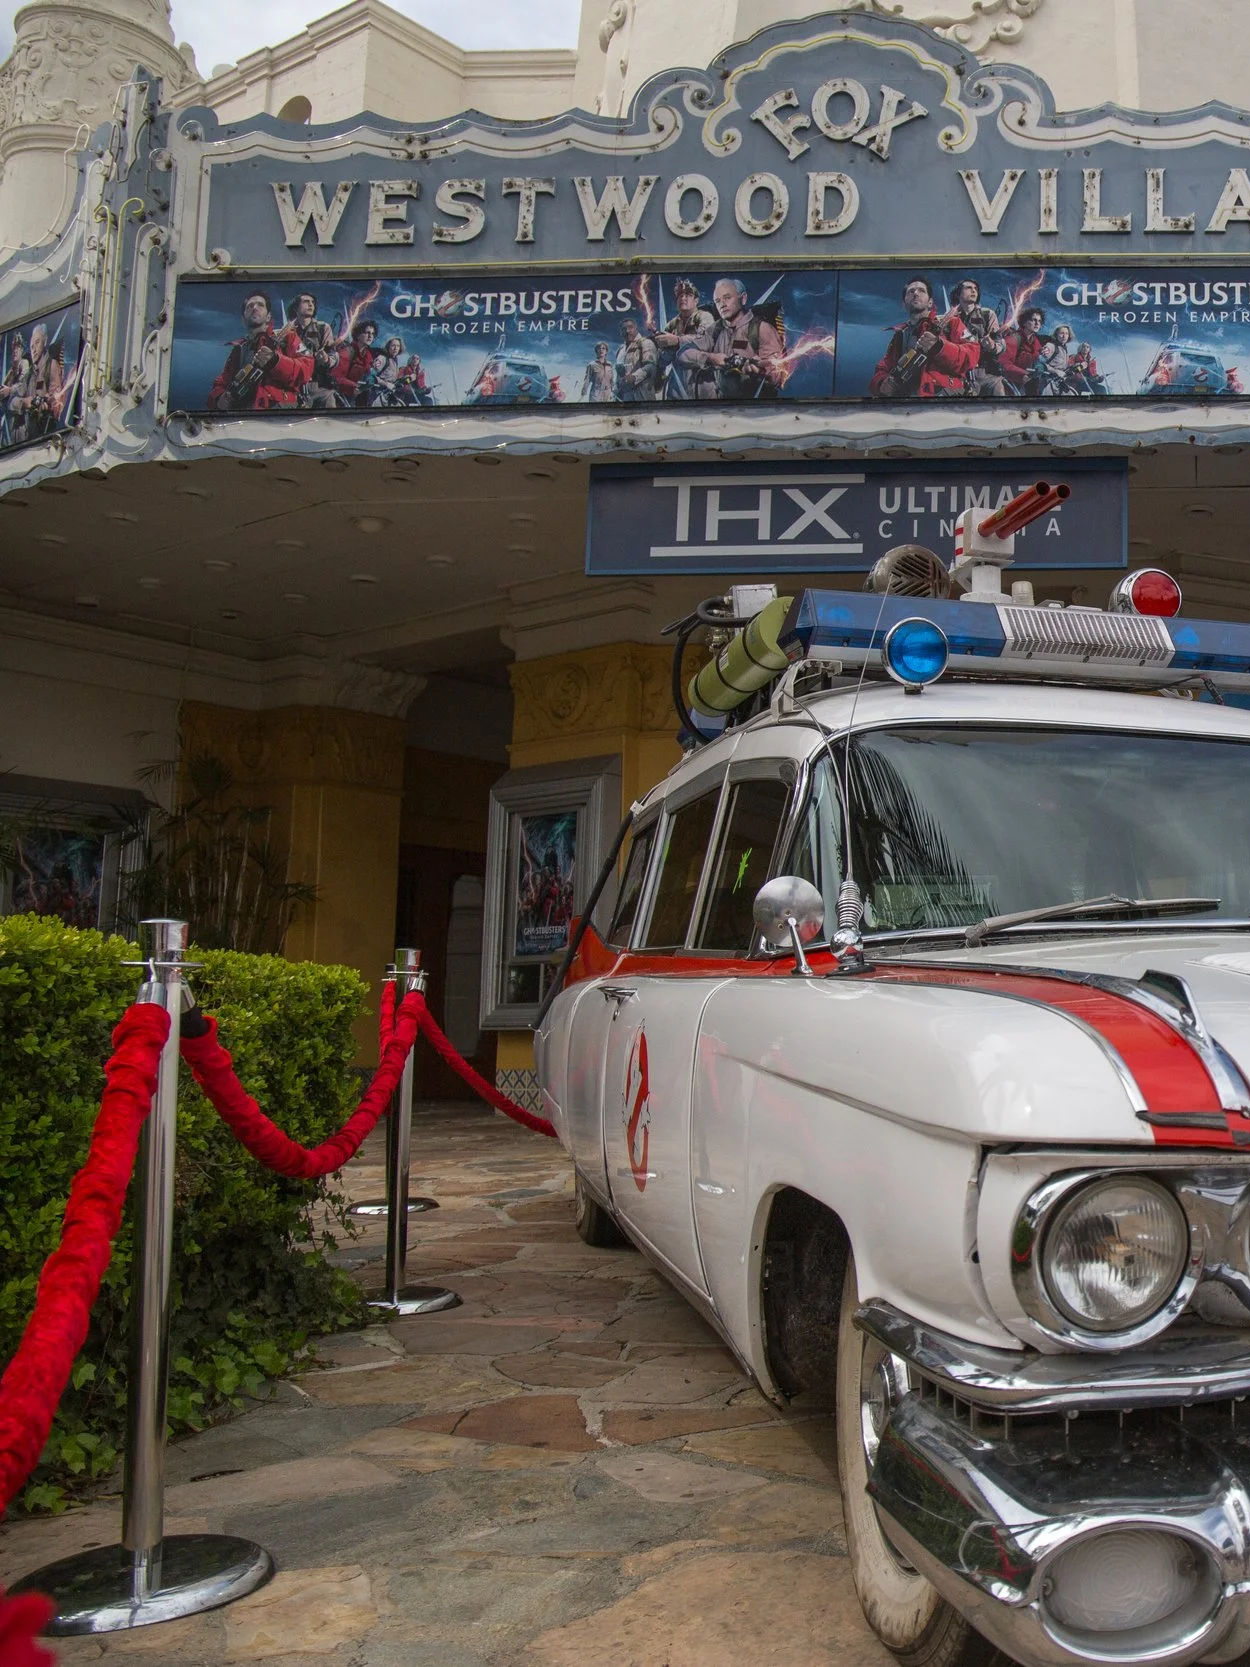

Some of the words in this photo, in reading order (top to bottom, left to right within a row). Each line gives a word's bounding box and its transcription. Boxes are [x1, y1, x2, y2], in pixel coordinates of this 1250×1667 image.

[750, 77, 930, 161] FOX
[269, 171, 861, 248] WESTWOOD
[390, 288, 634, 318] GHOSTBUSTERS
[1099, 311, 1178, 323] FROZEN
[430, 321, 506, 335] FROZEN
[518, 319, 590, 332] EMPIRE
[879, 485, 1062, 513] ULTIMA
[650, 474, 866, 557] THX
[878, 518, 1062, 538] CINA
